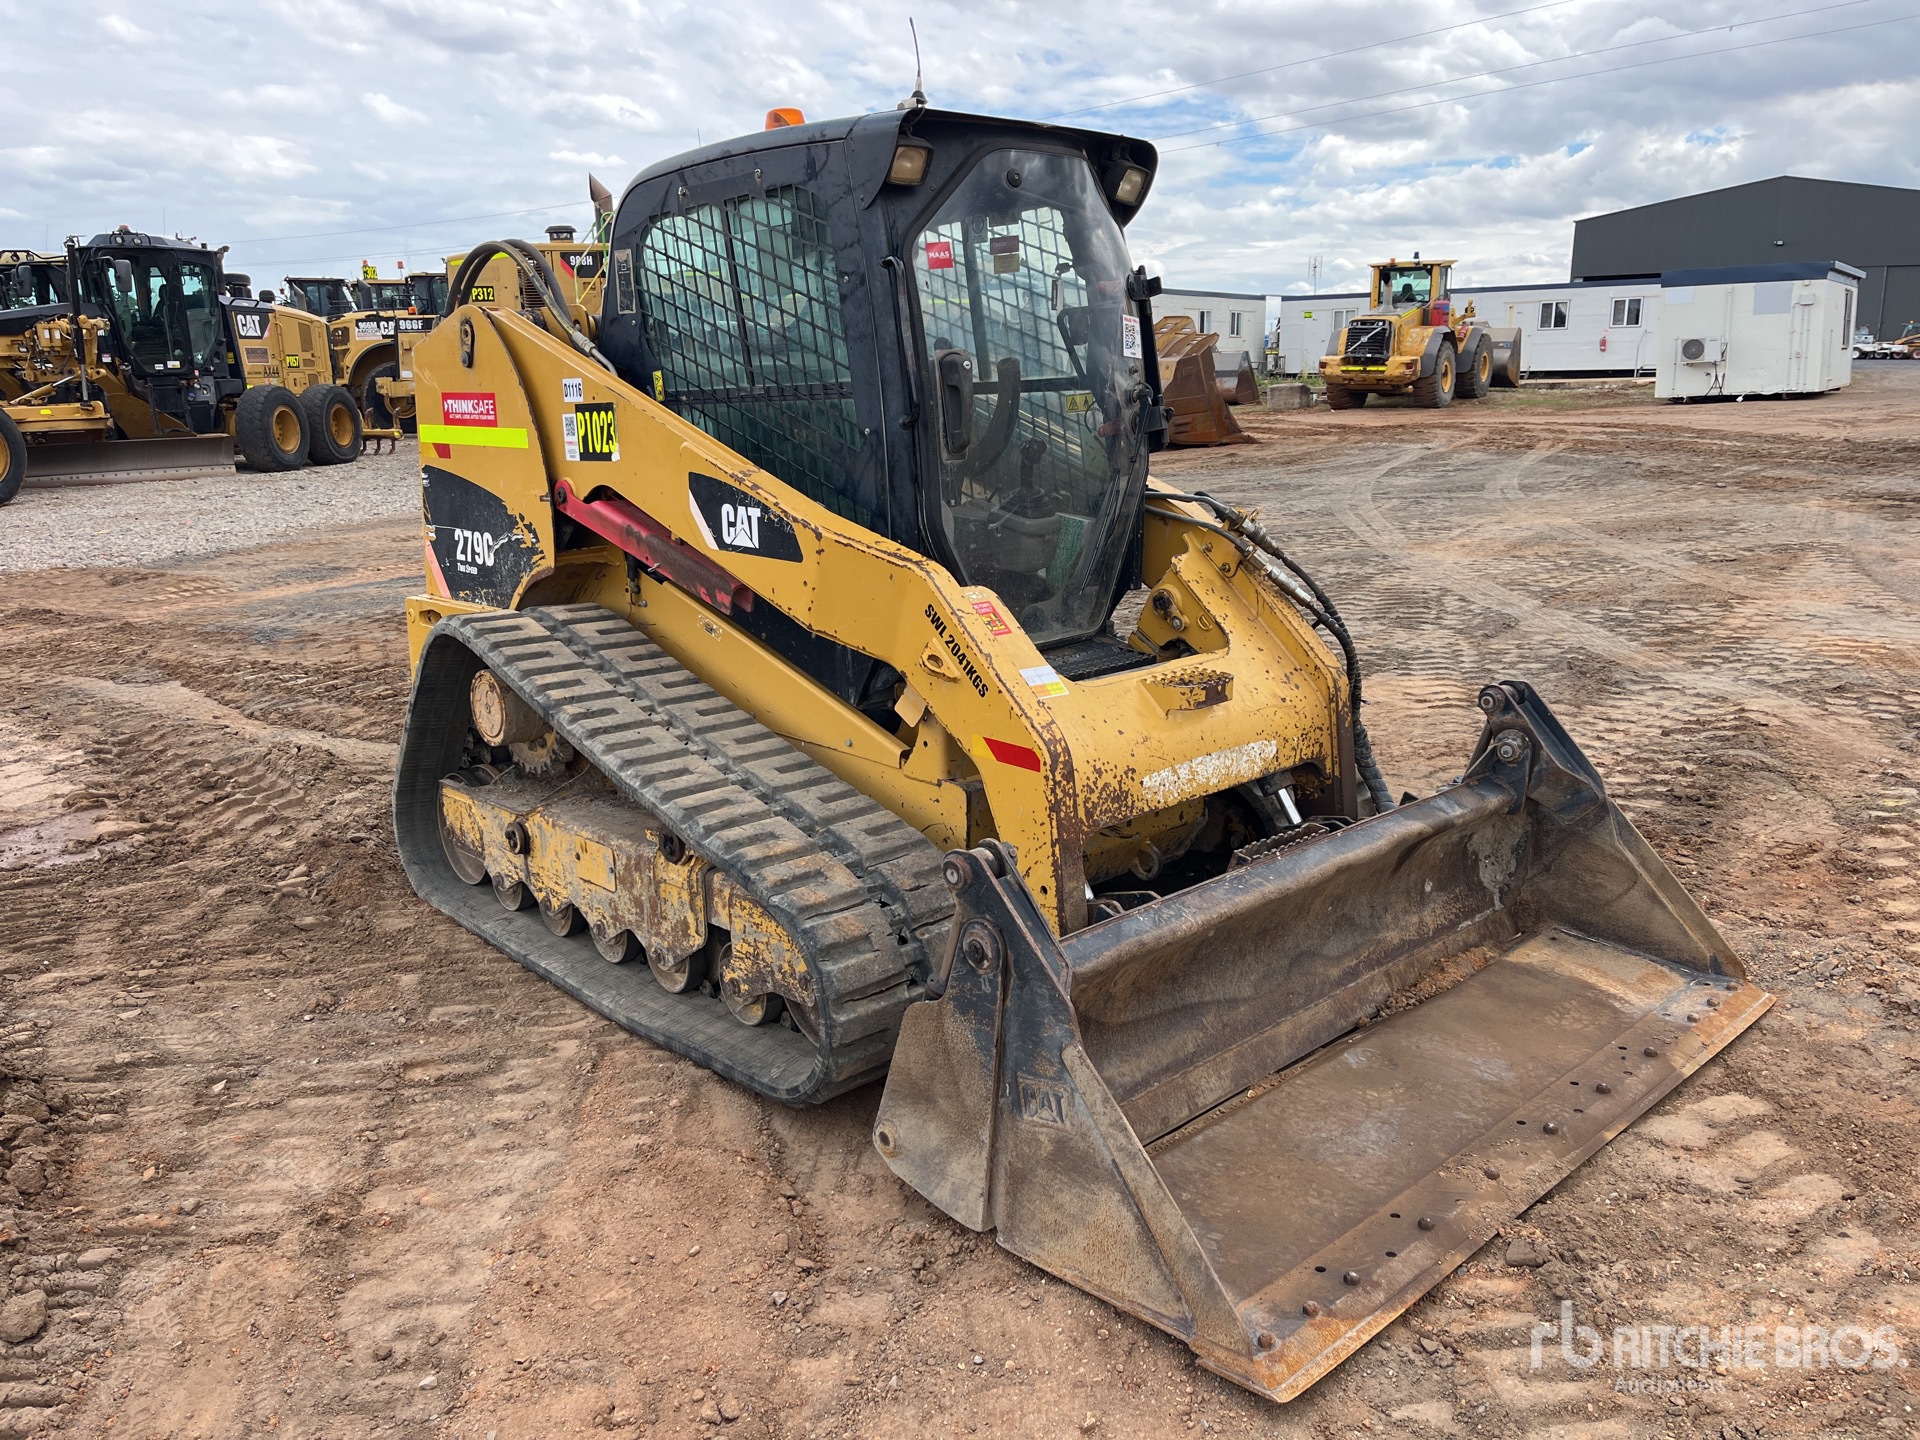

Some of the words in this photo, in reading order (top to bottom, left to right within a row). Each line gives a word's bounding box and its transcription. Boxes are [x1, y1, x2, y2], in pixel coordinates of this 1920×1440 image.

[928, 251, 950, 260] MAAS
[471, 287, 494, 301] P312
[236, 314, 262, 337] CAT
[380, 321, 395, 335] CA
[399, 319, 423, 330] 966F
[563, 382, 583, 398] D1116
[446, 399, 495, 415] THINKSAFE
[576, 410, 617, 453] P1023
[721, 503, 761, 549] CAT
[454, 528, 495, 567] 279C
[924, 603, 947, 639] SWL
[944, 634, 989, 698] 2041KGS
[1021, 1083, 1065, 1124] CAT
